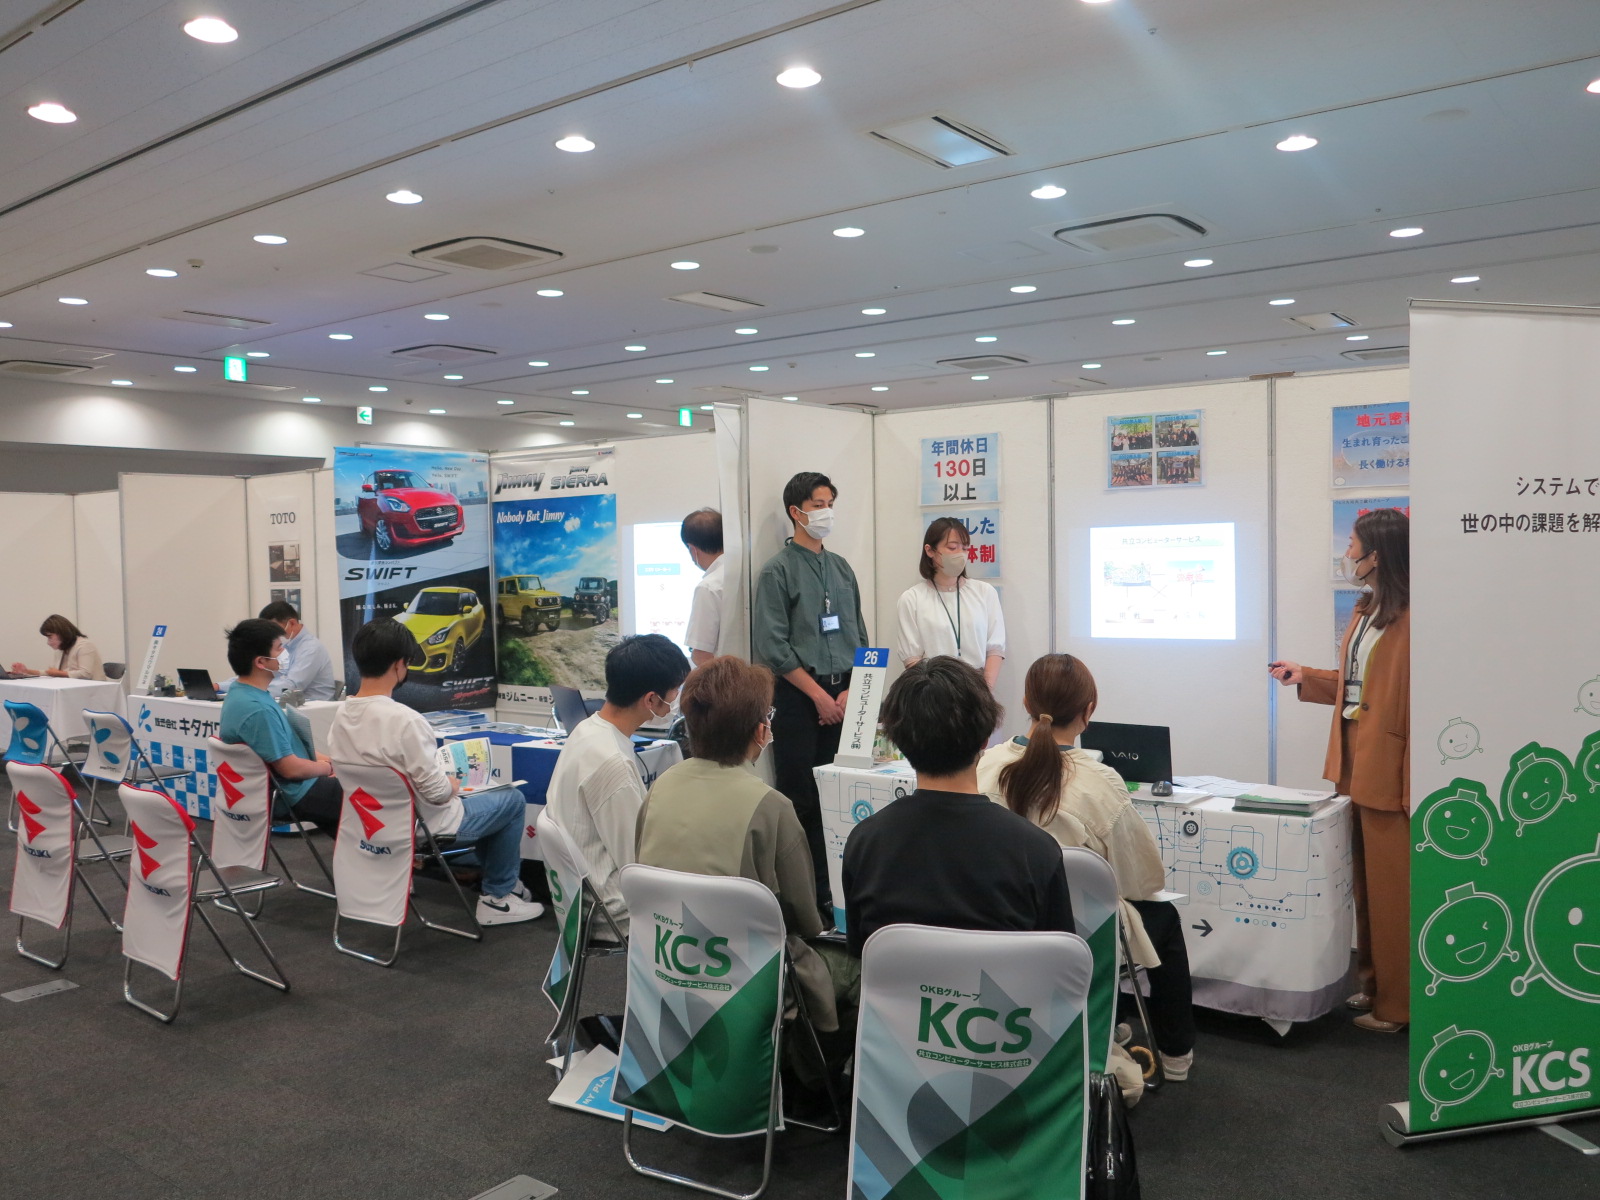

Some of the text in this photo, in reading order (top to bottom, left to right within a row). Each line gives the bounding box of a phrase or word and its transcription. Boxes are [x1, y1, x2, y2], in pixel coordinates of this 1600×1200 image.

[931, 437, 988, 456] 年間休日
[934, 458, 986, 477] 130日
[550, 473, 609, 490] SIERRA
[1516, 476, 1600, 497] システムで
[943, 482, 977, 502] 以上
[270, 511, 296, 525] TOTO
[496, 509, 565, 525] Nobody But Jimny
[1461, 512, 1600, 534] 世の中の課題を解
[344, 566, 418, 581] SWIFT
[863, 650, 879, 665] 26
[1111, 751, 1139, 761] VAIO
[360, 839, 392, 855] SUZUKI
[655, 923, 732, 978] KCS
[920, 984, 981, 1001] OKBグループ
[918, 996, 1033, 1055] KCS
[1512, 1040, 1553, 1052] OKBグループ
[918, 1050, 1030, 1069] 共立コンピューターサービス株式会社
[1512, 1047, 1591, 1096] KCS
[582, 1093, 595, 1105] MY
